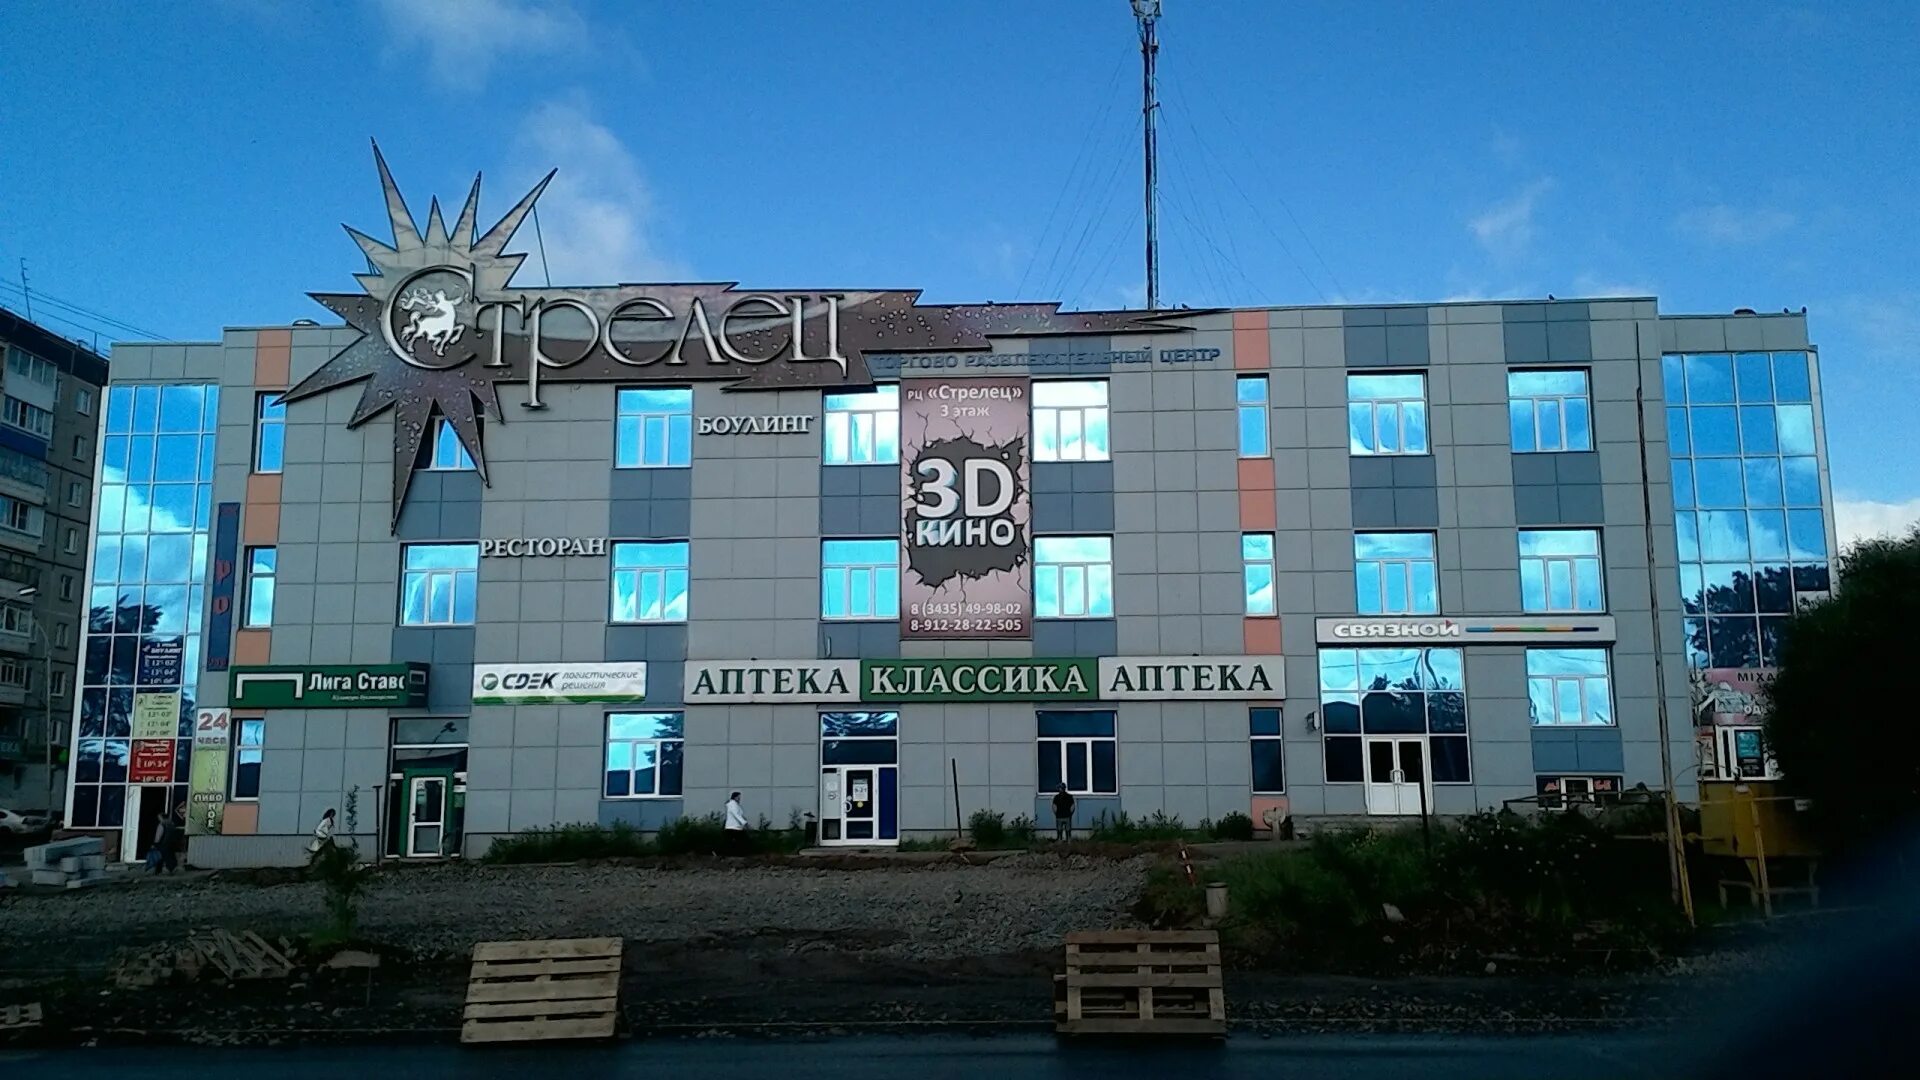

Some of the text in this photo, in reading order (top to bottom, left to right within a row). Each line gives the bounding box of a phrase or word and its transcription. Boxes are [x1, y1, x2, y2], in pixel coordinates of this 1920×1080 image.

[379, 263, 849, 410] Стрелец
[1159, 348, 1221, 364] ЦЕНТР
[907, 385, 1023, 402] РЦ «Стрелец»
[940, 404, 990, 417] 3 этаж
[697, 415, 814, 435] БОУЛИНГ
[916, 457, 1016, 519] 3D
[915, 518, 1016, 547] КИНО
[479, 537, 608, 557] РЕСТОРАН
[911, 602, 1022, 617] 8 (3435) 49-98-02
[910, 619, 1022, 632] 8-912-28-22-505
[308, 673, 352, 690] Лига
[502, 672, 560, 690] CDEK
[562, 671, 638, 680] логистические
[692, 668, 851, 694] АПТЕКА
[870, 665, 1089, 694] КЛАССИКА
[1109, 664, 1273, 692] АПТЕКА
[561, 682, 607, 691] решения
[198, 711, 228, 731] 24
